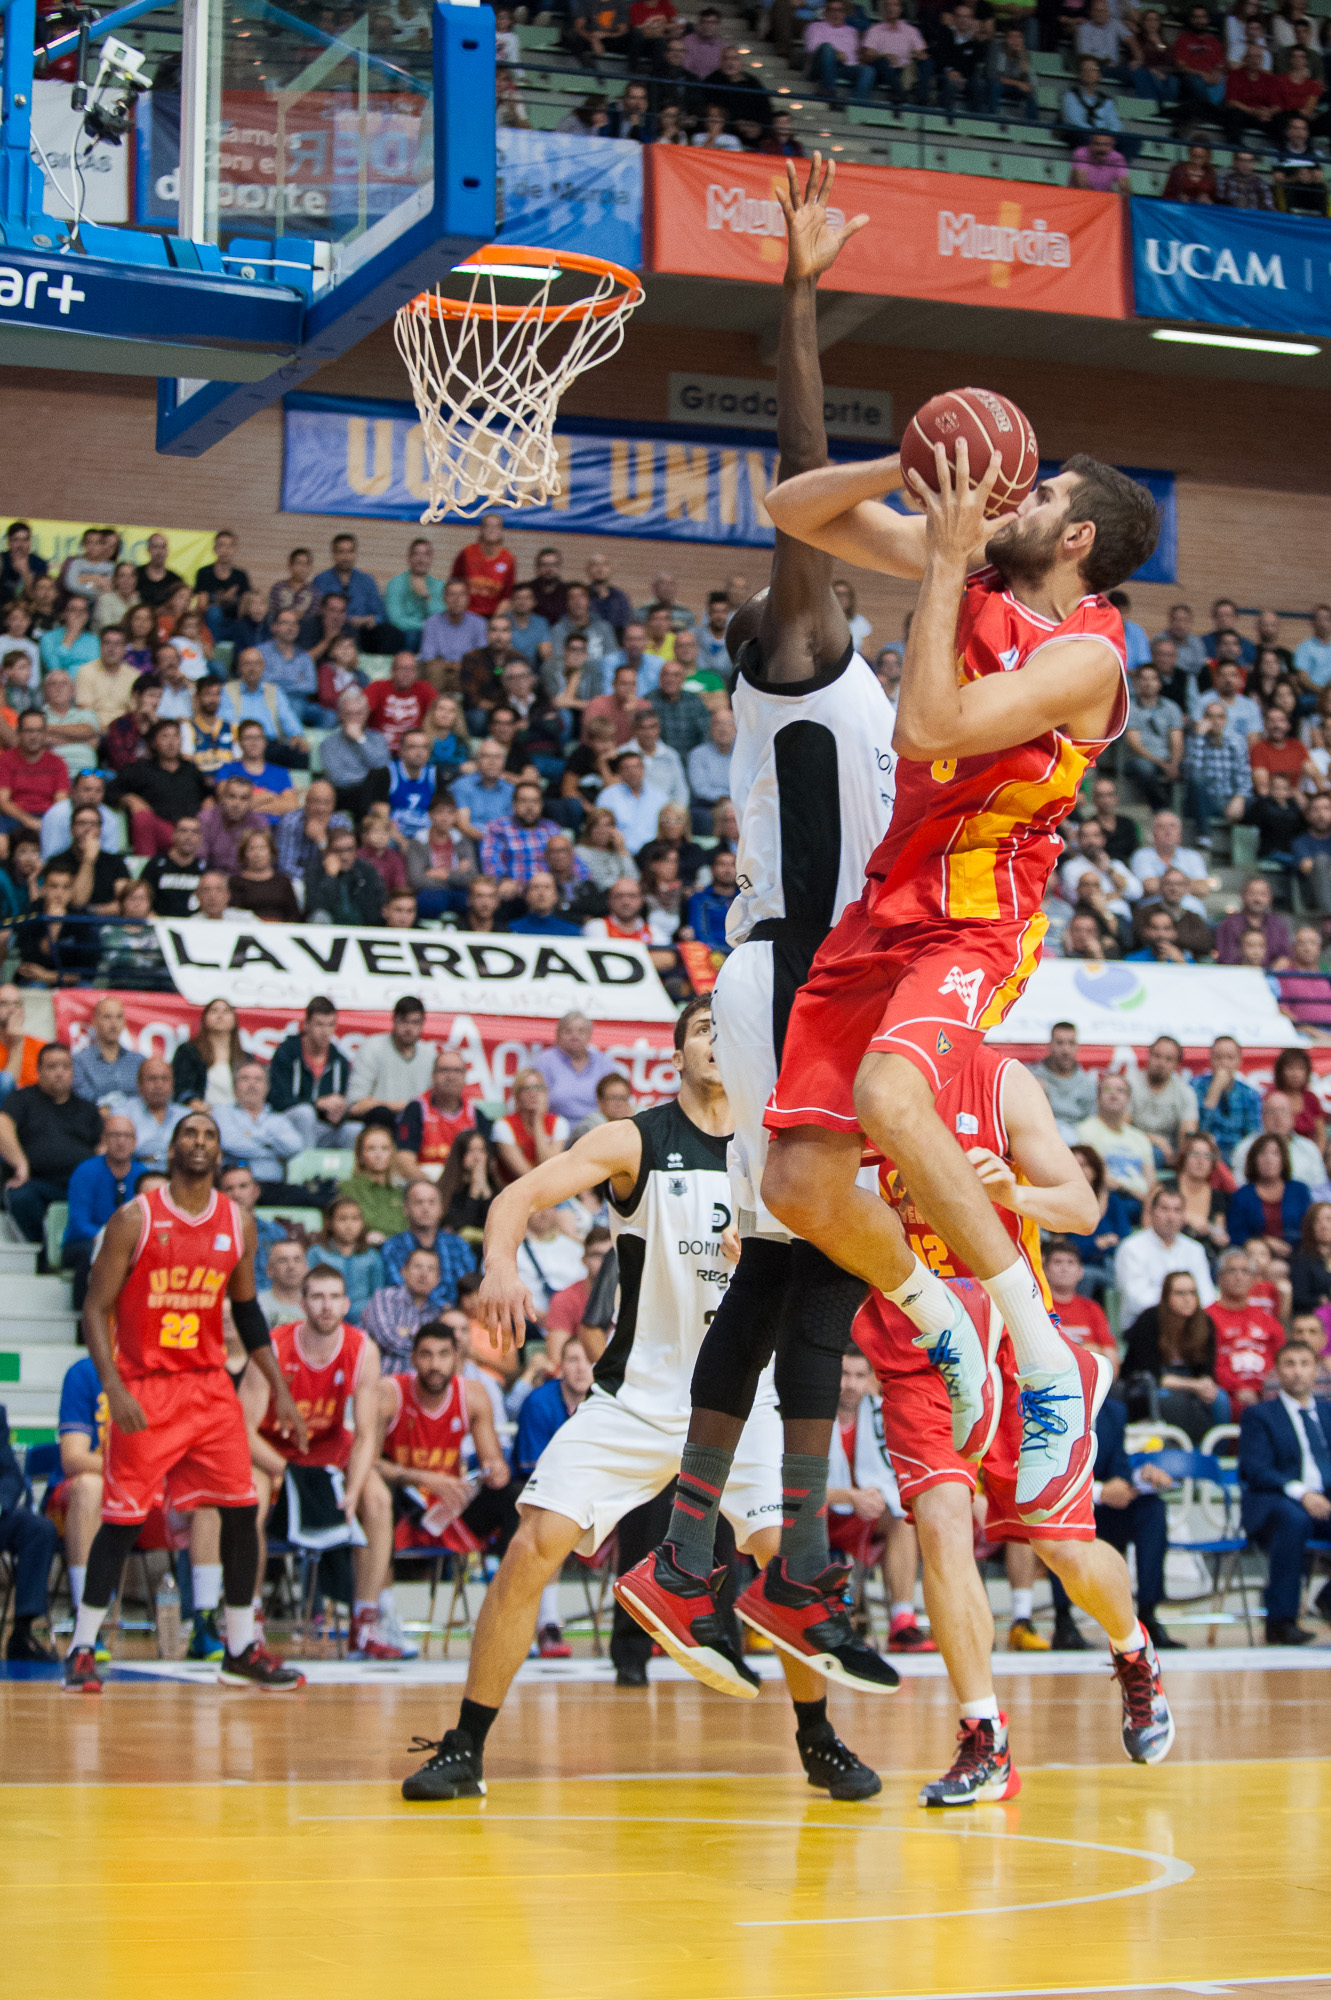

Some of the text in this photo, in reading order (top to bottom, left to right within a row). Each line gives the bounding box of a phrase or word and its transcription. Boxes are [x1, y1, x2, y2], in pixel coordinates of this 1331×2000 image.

[938, 210, 1071, 268] Murcia
[1144, 237, 1288, 290] UCAM
[149, 1265, 226, 1296] UCAM
[160, 1311, 200, 1350] 22
